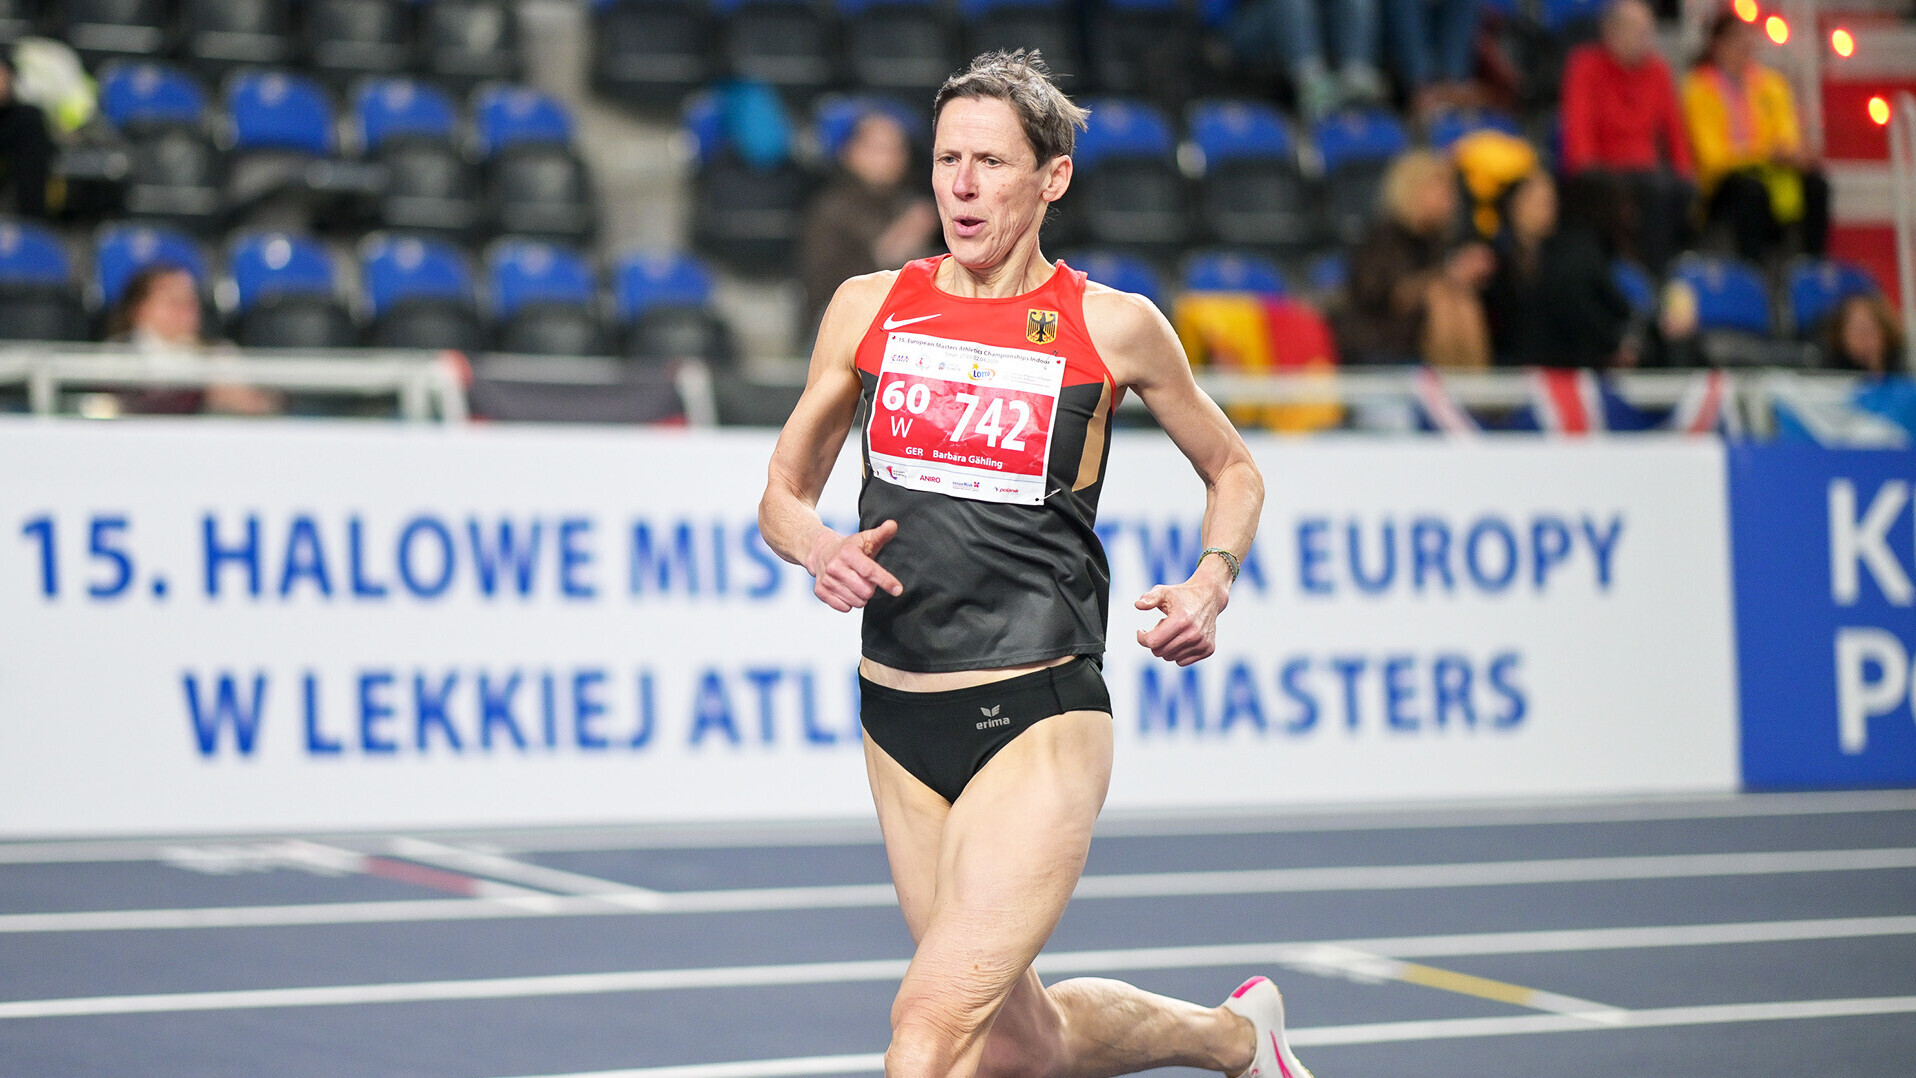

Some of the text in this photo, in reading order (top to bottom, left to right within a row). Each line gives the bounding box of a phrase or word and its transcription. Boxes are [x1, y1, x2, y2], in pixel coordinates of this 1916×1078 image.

[907, 338, 934, 347] European
[935, 342, 957, 351] Masters
[959, 346, 982, 355] Athletics
[984, 349, 1029, 361] Championships
[1030, 356, 1050, 365] Indoor
[882, 380, 930, 414] 60
[890, 416, 913, 438] W
[949, 392, 1030, 452] 742
[905, 446, 1003, 469] GER Barbara Gähling
[920, 475, 941, 483] ANIRO
[20, 515, 170, 598] 15.
[202, 514, 600, 598] HALOWE
[1296, 513, 1625, 593] EUROPY
[1828, 477, 1916, 606] K
[183, 653, 1528, 756] W LEKKIEJ ATL MASTERS
[1834, 627, 1916, 755] P
[976, 717, 1010, 730] erima
